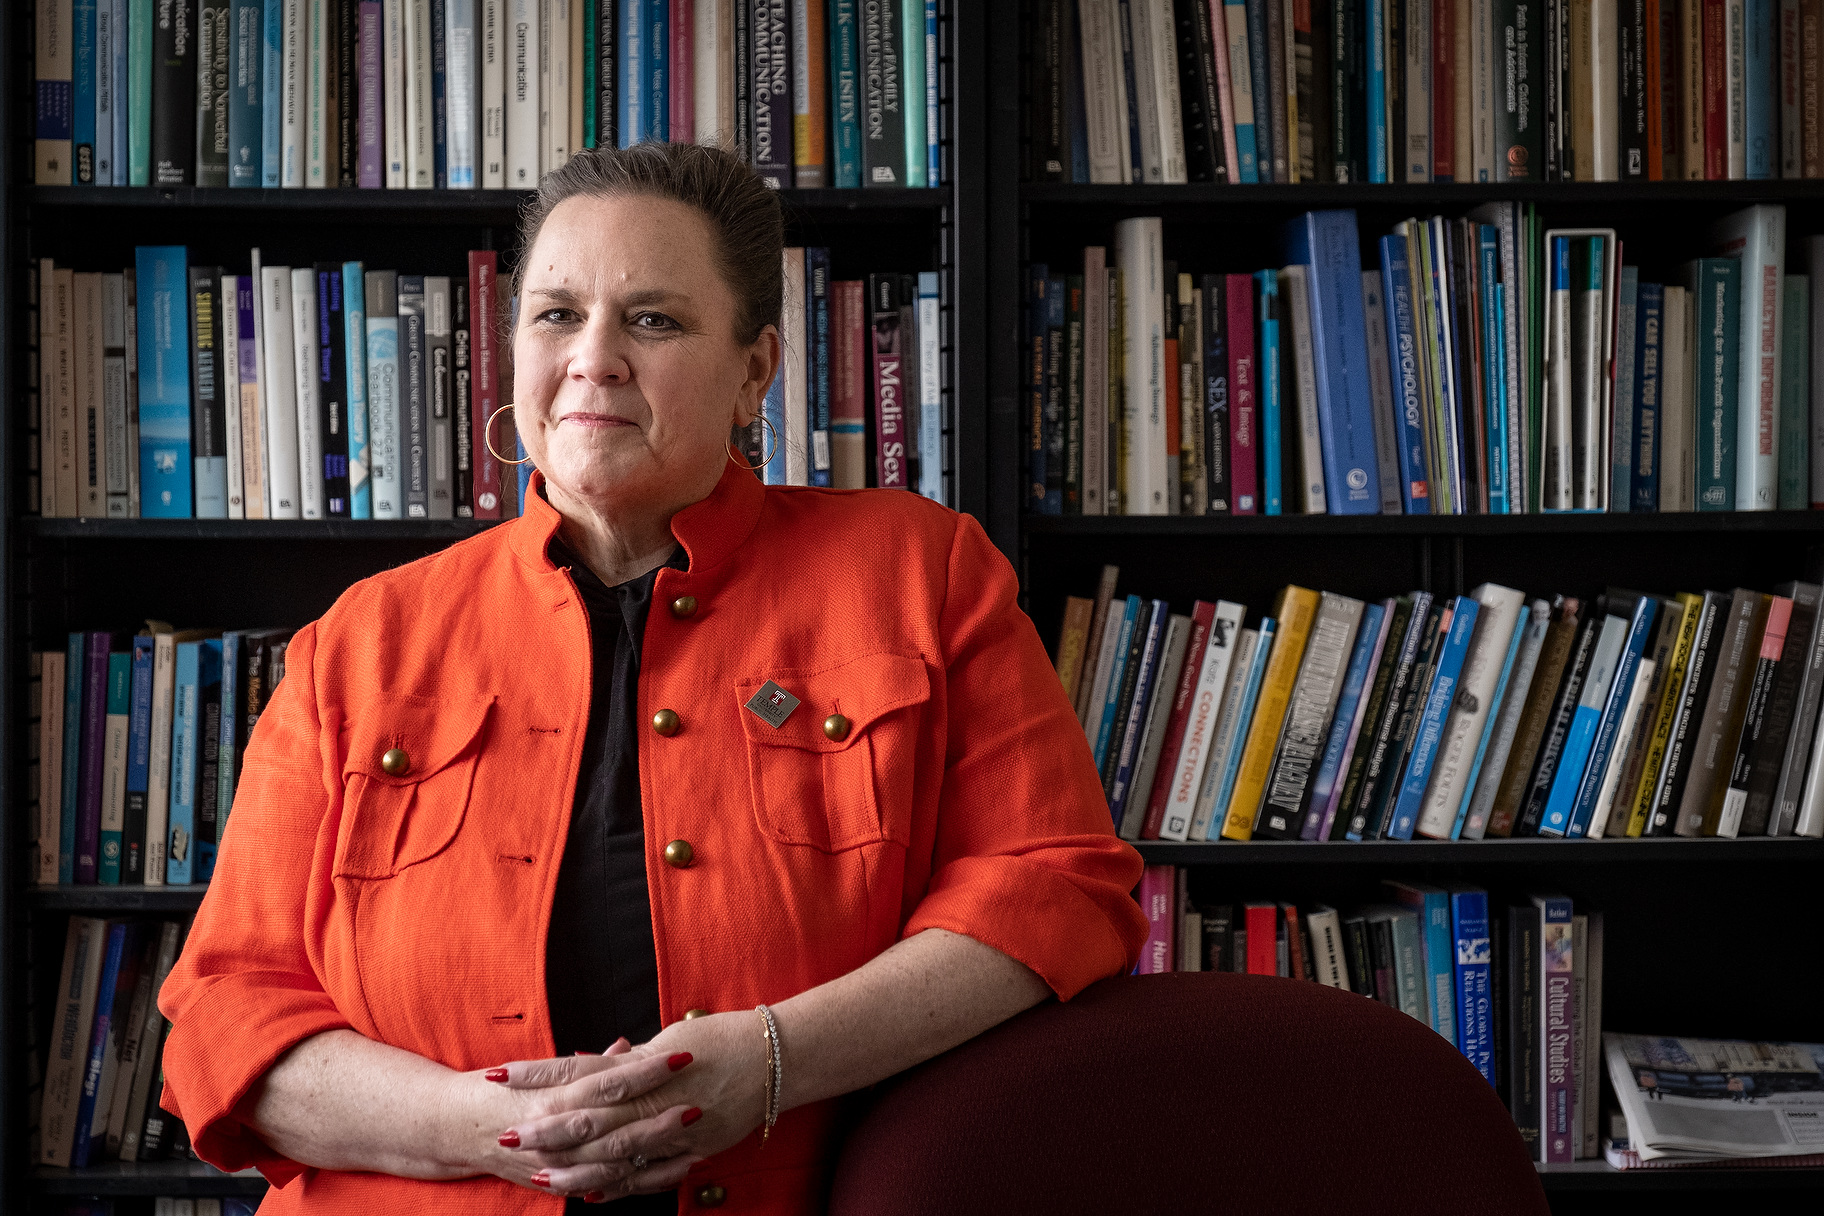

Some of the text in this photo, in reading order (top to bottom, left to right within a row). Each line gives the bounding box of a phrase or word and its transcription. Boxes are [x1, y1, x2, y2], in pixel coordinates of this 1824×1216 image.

[100, 34, 109, 87] Communication
[200, 7, 215, 111] Communication
[433, 41, 445, 73] SKILLS
[515, 23, 530, 102] Communication
[770, 0, 787, 96] TEACHING
[1516, 30, 1528, 42] in
[213, 7, 230, 154] Sensitivity to Nonverbal
[362, 14, 377, 146] DIMENSIONS OF COMMUNICATION
[601, 46, 614, 89] IN GROUP
[754, 0, 772, 162] COMMUNICATION
[883, 54, 898, 113] FAMILY
[1505, 26, 1517, 113] and Adolescents
[839, 70, 854, 124] LISTEN
[79, 147, 92, 182] USED
[194, 292, 214, 349] SHOOTING
[329, 272, 341, 312] Building
[1395, 285, 1411, 331] HEALTH
[1713, 280, 1727, 335] Marketing
[318, 272, 331, 383] Communication Theory
[1644, 317, 1659, 346] CAN
[1714, 337, 1726, 353] for
[197, 351, 215, 401] KENNEDY
[350, 311, 365, 444] Communication Theory
[480, 350, 491, 391] Education
[1032, 335, 1043, 385] NATURAL
[1398, 333, 1420, 428] PSYCHOLOGY
[1643, 347, 1658, 376] SELL
[1758, 265, 1777, 456] MARKETING INFORMATION
[369, 363, 384, 456] Yearbook 27
[408, 316, 422, 491] GROUP COMMUNICATION IN CONTEXT
[455, 329, 471, 471] Crisis Communications
[1207, 376, 1227, 413] SEX
[1235, 355, 1252, 447] Text & Image
[1642, 378, 1657, 406] YOU
[382, 363, 397, 483] Communication
[879, 361, 904, 485] Media Sex
[1638, 408, 1655, 477] ANYTHING
[1403, 596, 1430, 653] Conversation
[1681, 620, 1695, 641] NEW
[247, 655, 260, 713] The Media
[1393, 651, 1414, 690] Analysis
[755, 694, 785, 718] TEMPLE
[1174, 657, 1221, 805] Katz CONNECTIONS
[1377, 699, 1401, 743] Discourse
[1666, 648, 1706, 779] CONCEPTS IN SOCIAL SCIENCE
[1365, 740, 1388, 779] Analysis
[1412, 719, 1441, 779] Differences
[1535, 726, 1564, 789] ERIKSON
[1434, 765, 1458, 810] FOUTS
[1324, 927, 1340, 980] WHERE DO THE
[1463, 970, 1477, 1036] RELATIONS
[1476, 969, 1490, 1046] THE GLOBAL
[1548, 977, 1570, 1084] Cultural Studies
